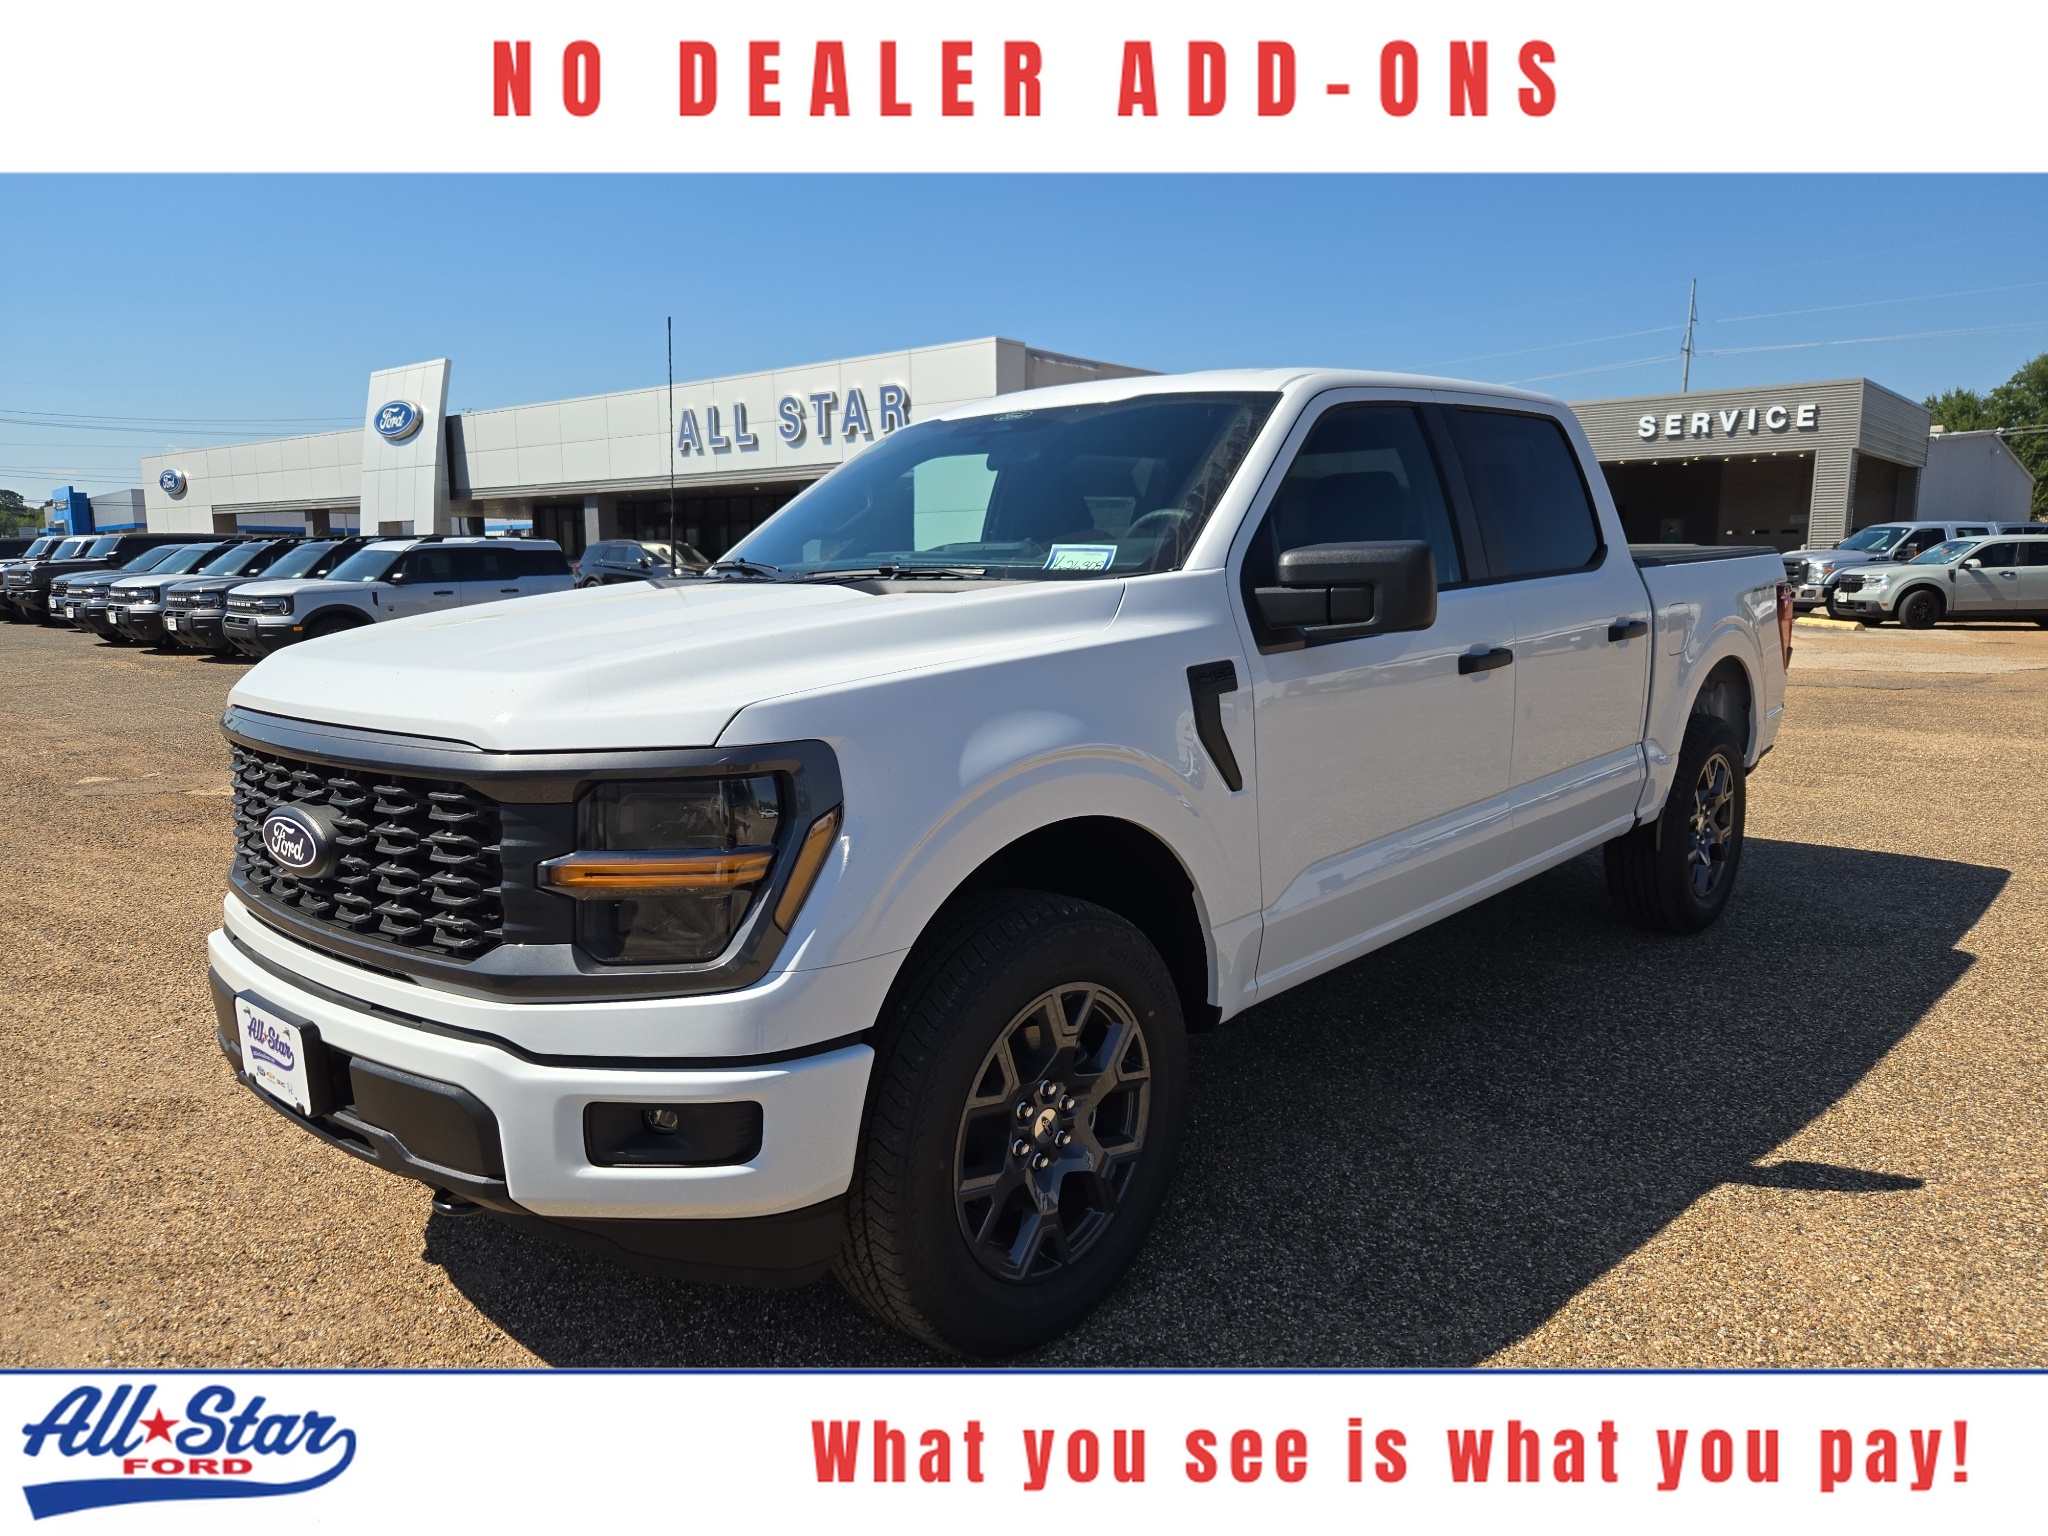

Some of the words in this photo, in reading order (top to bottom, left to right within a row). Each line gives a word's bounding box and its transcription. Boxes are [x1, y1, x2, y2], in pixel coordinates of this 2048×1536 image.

[380, 407, 405, 430] Ford
[677, 402, 754, 451] ALL
[778, 384, 906, 441] STAR
[1637, 404, 1816, 438] SERVICE
[272, 822, 304, 861] Ford
[247, 1016, 265, 1044] All
[267, 1026, 293, 1060] Star
